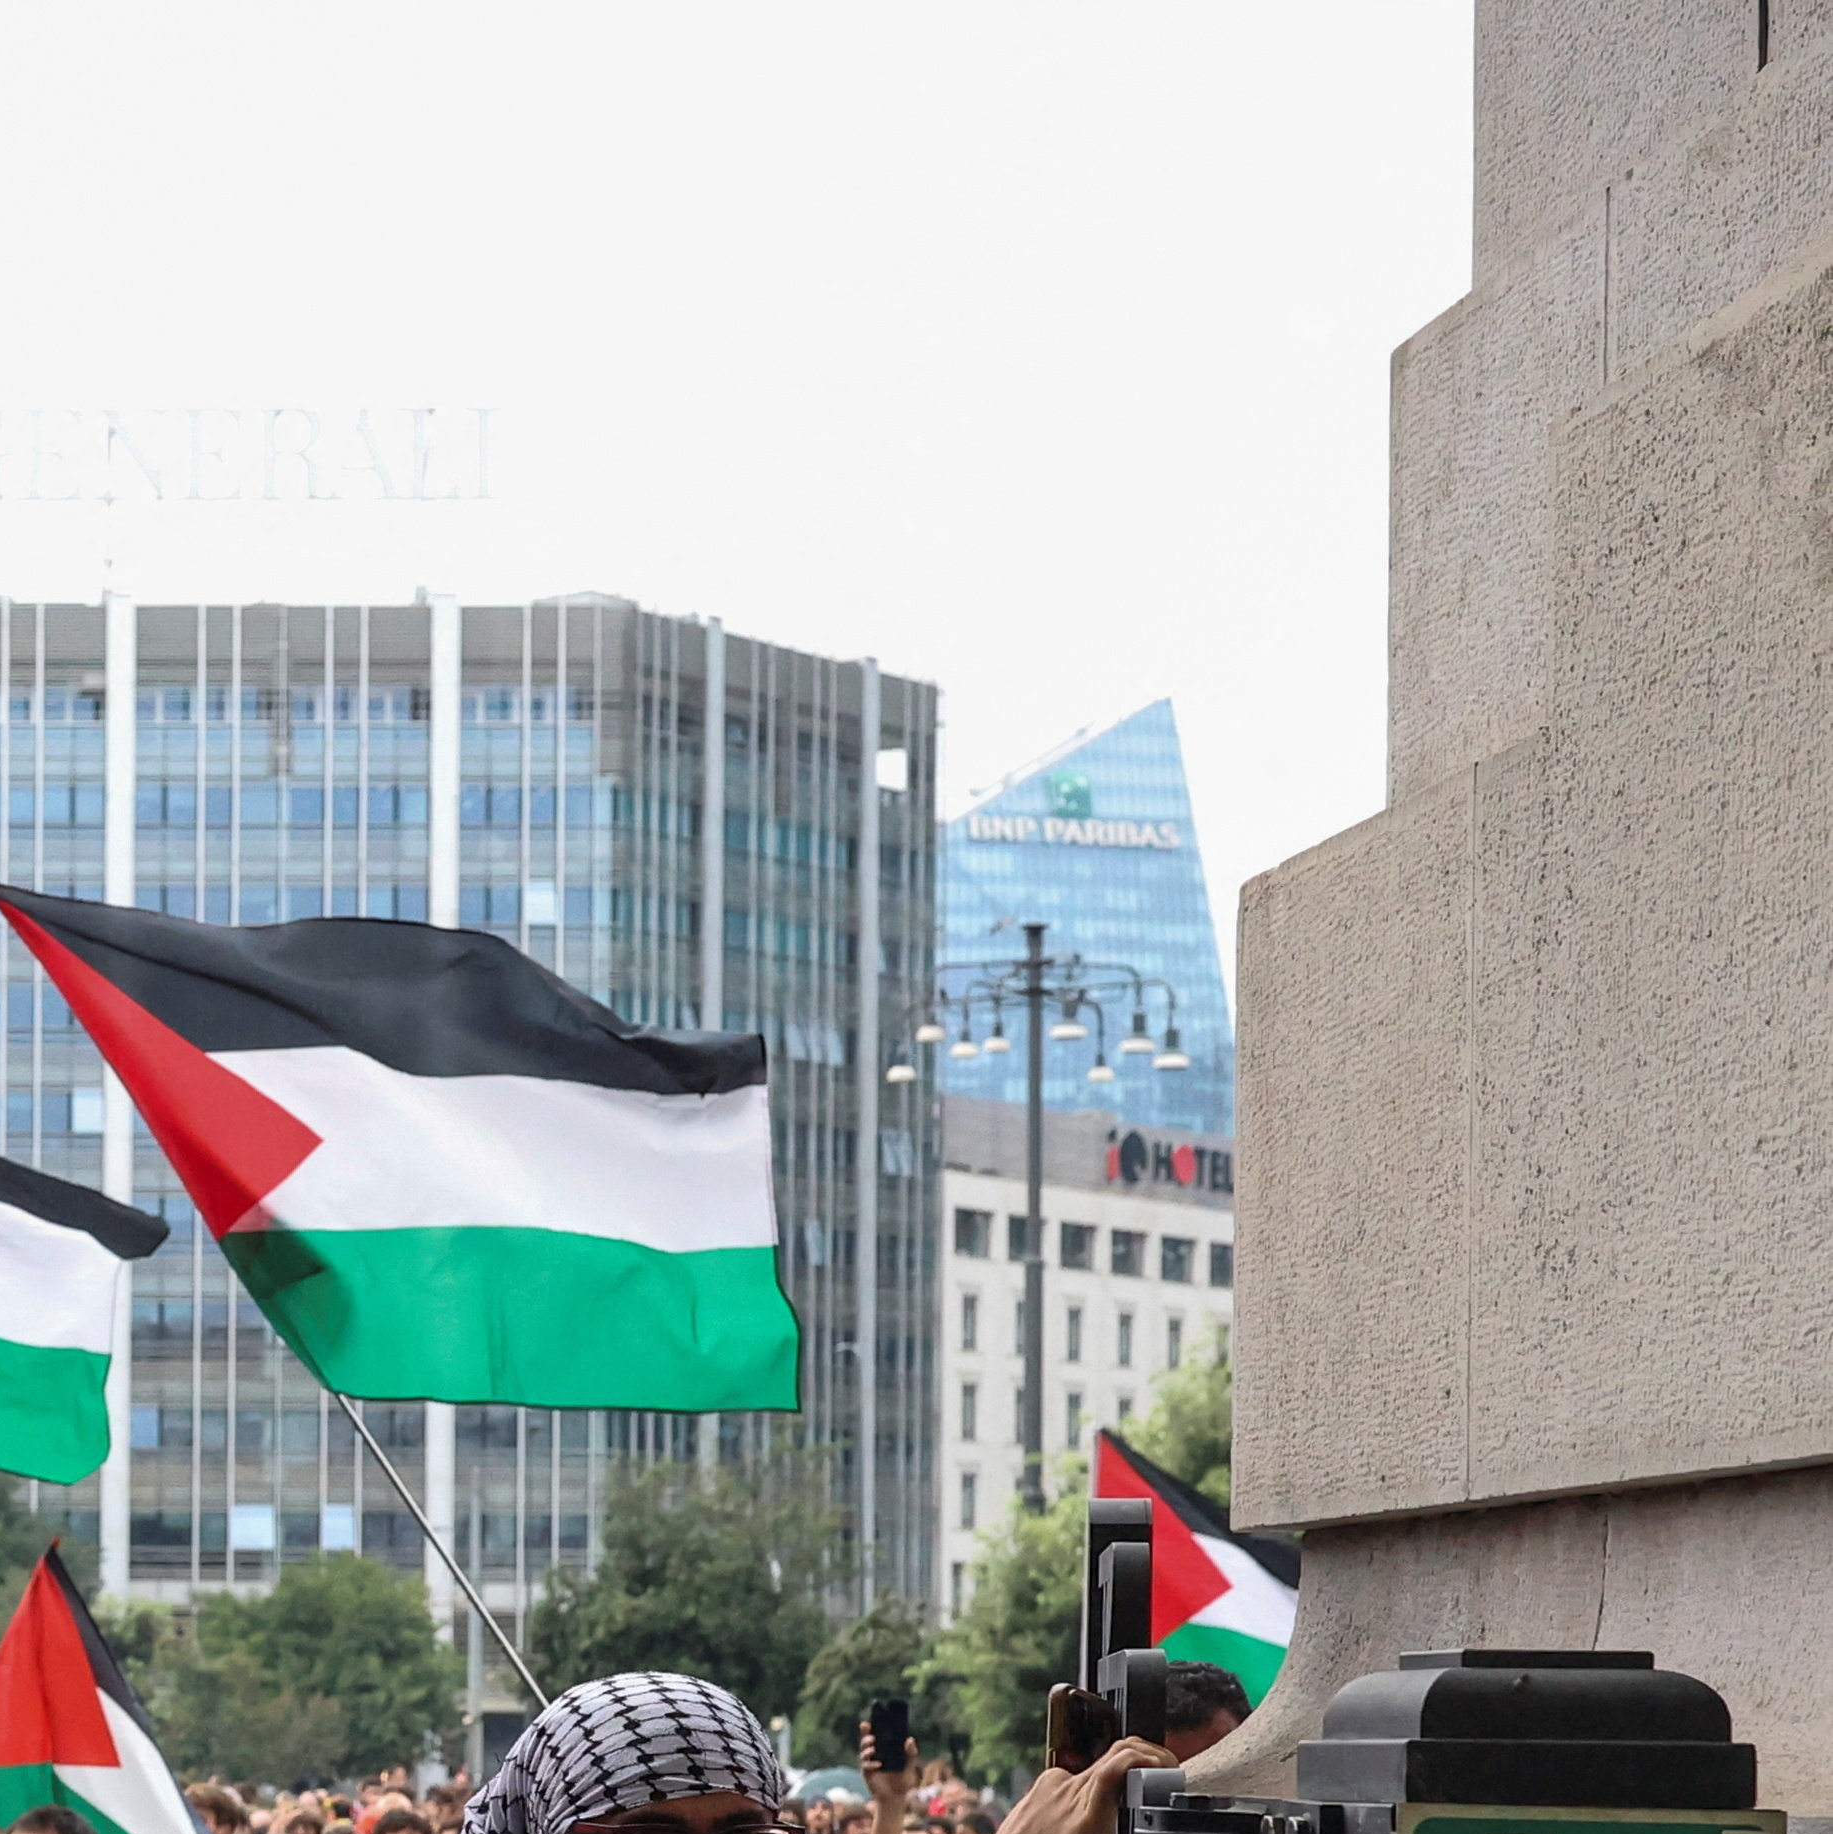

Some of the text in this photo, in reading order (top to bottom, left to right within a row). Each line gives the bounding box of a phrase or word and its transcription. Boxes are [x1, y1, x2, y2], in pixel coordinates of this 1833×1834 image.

[967, 814, 1181, 850] BNP PARIBAS
[1152, 1141, 1234, 1193] HOTEL
